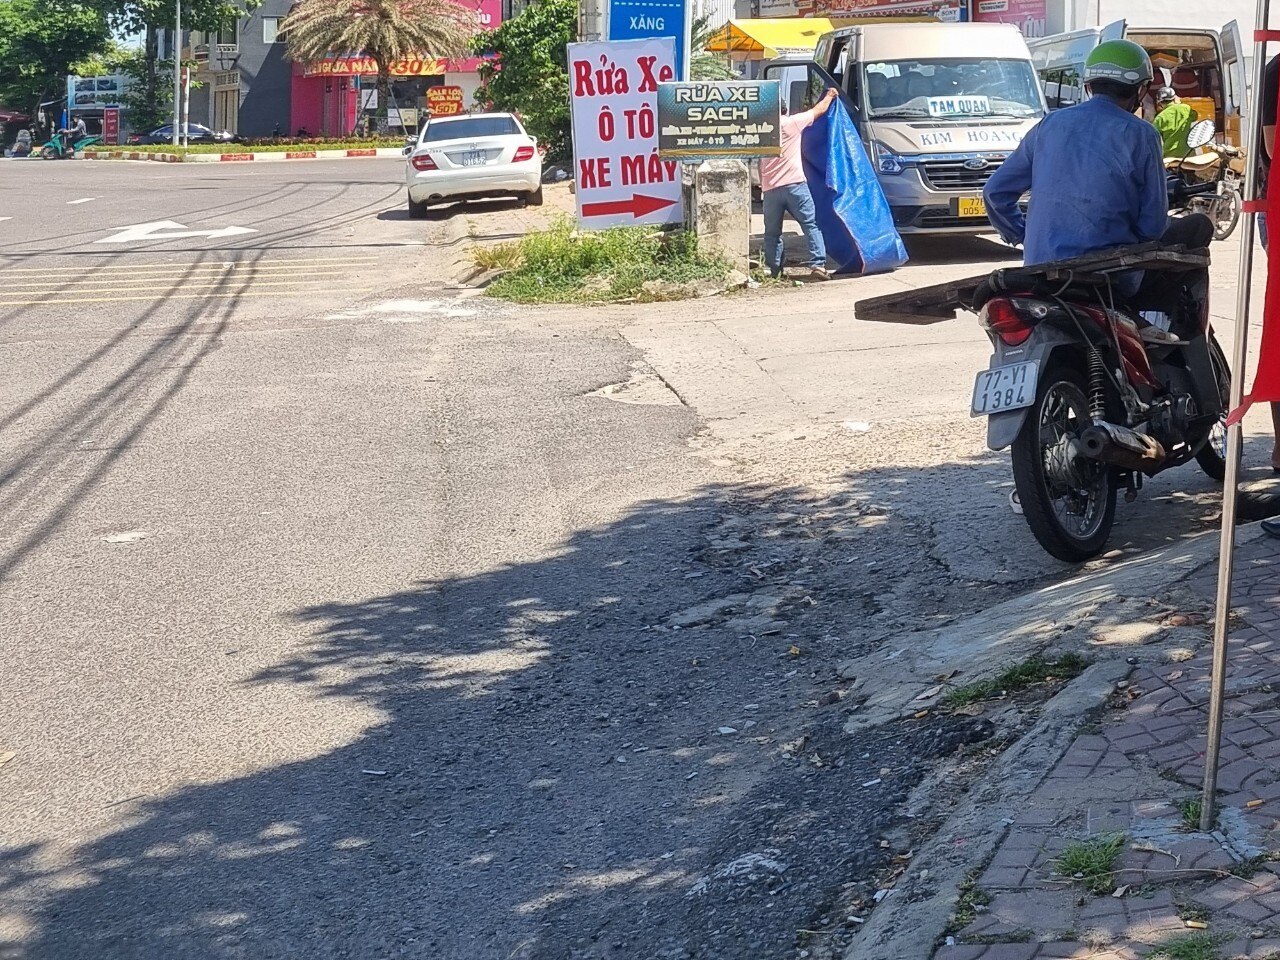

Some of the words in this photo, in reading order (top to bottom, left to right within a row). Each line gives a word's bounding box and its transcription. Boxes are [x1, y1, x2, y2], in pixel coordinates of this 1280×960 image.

[629, 14, 665, 30] XĂNG
[573, 54, 629, 97] Rửa
[637, 55, 673, 93] Xe
[675, 84, 723, 102] RỬA
[729, 87, 758, 101] XE
[687, 106, 748, 124] SẠCH
[930, 100, 955, 113] TAM
[958, 100, 987, 113] QUAN
[598, 105, 615, 142] Ô
[624, 102, 655, 140] TÔ
[730, 134, 760, 146] 24/24
[920, 131, 952, 146] KIM
[967, 130, 1022, 142] HOANG
[580, 157, 612, 189] XE
[620, 147, 677, 186] MÁY
[984, 365, 1027, 391] 77-Y1
[981, 386, 1025, 411] 1384
